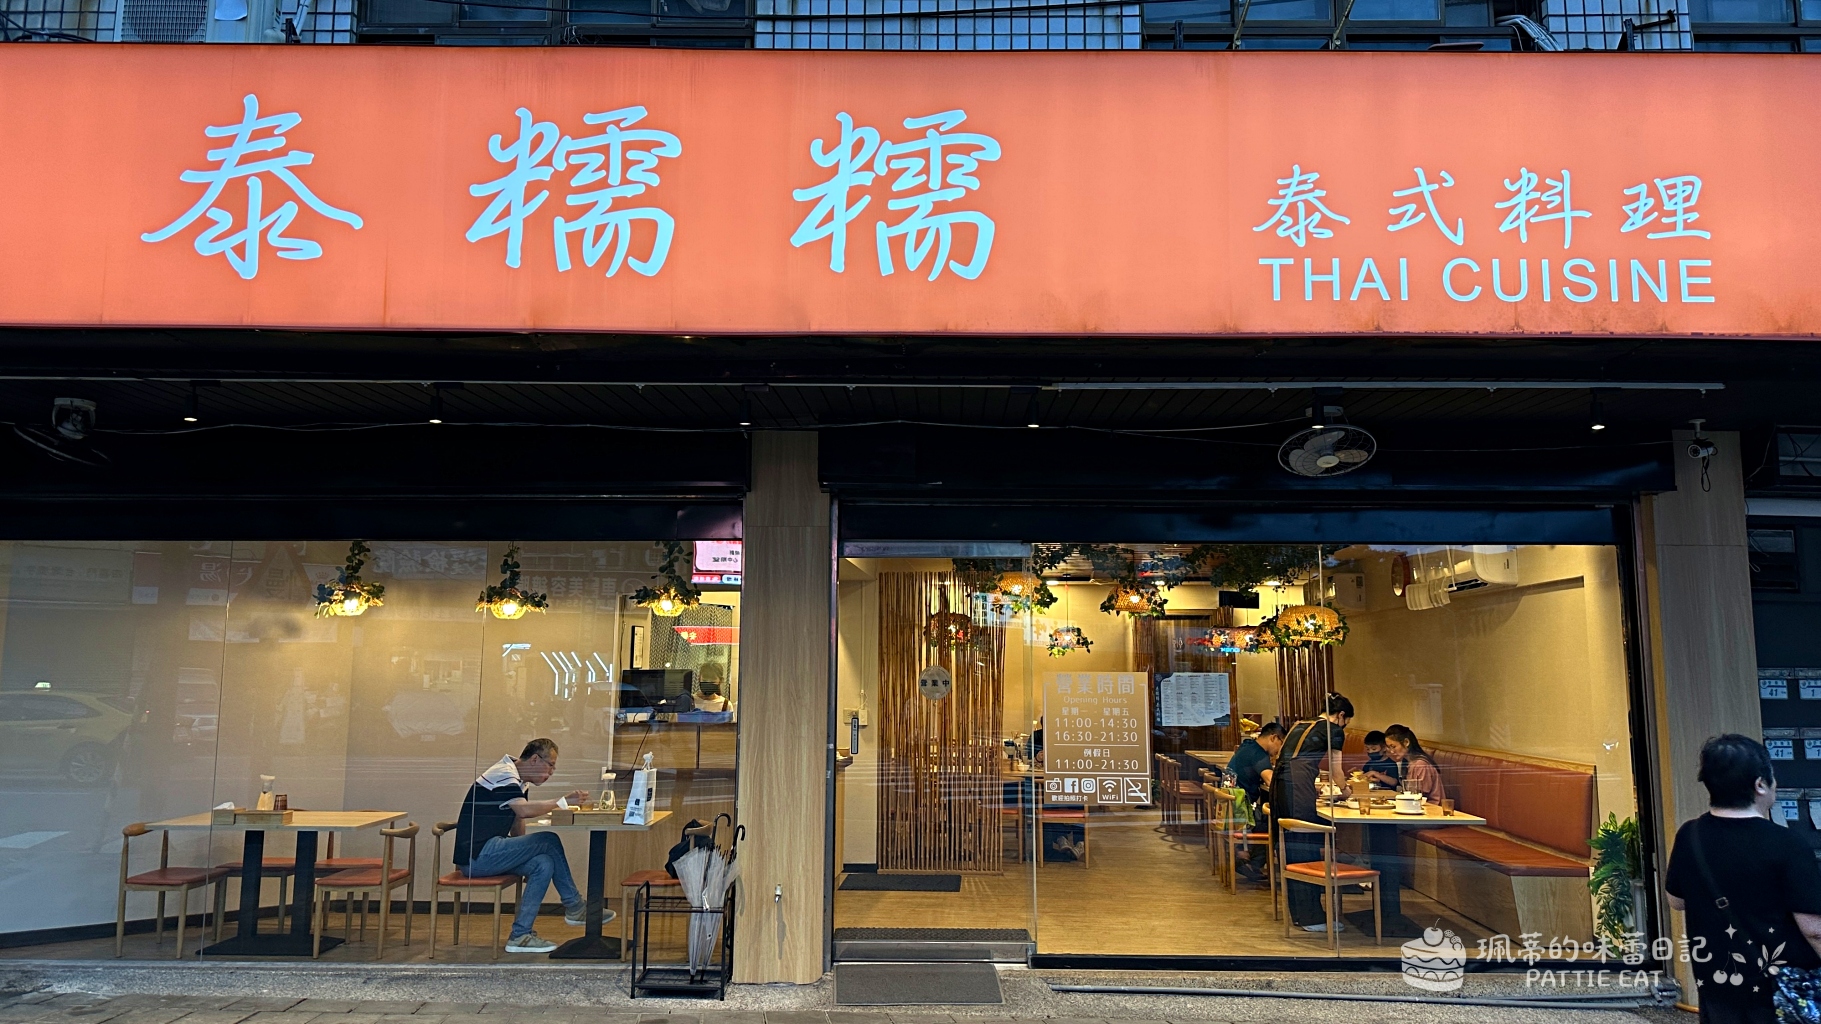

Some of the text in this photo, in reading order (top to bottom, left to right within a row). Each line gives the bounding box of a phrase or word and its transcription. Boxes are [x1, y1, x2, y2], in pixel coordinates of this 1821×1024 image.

[140, 94, 1002, 281] 泰糯糯
[1252, 164, 1712, 249] 泰式料理
[1258, 257, 1715, 303] THAI CUISINE
[1056, 673, 1135, 695] 營業時間
[1063, 696, 1128, 705] Opening Hours
[1062, 707, 1089, 716] 星期一
[1103, 708, 1130, 716] 星期五
[1054, 718, 1138, 729] 11:00-14:30
[1054, 731, 1138, 742] 16:30-21:30
[1083, 748, 1111, 758] 例假日
[1055, 759, 1139, 770] 11:00-21:30
